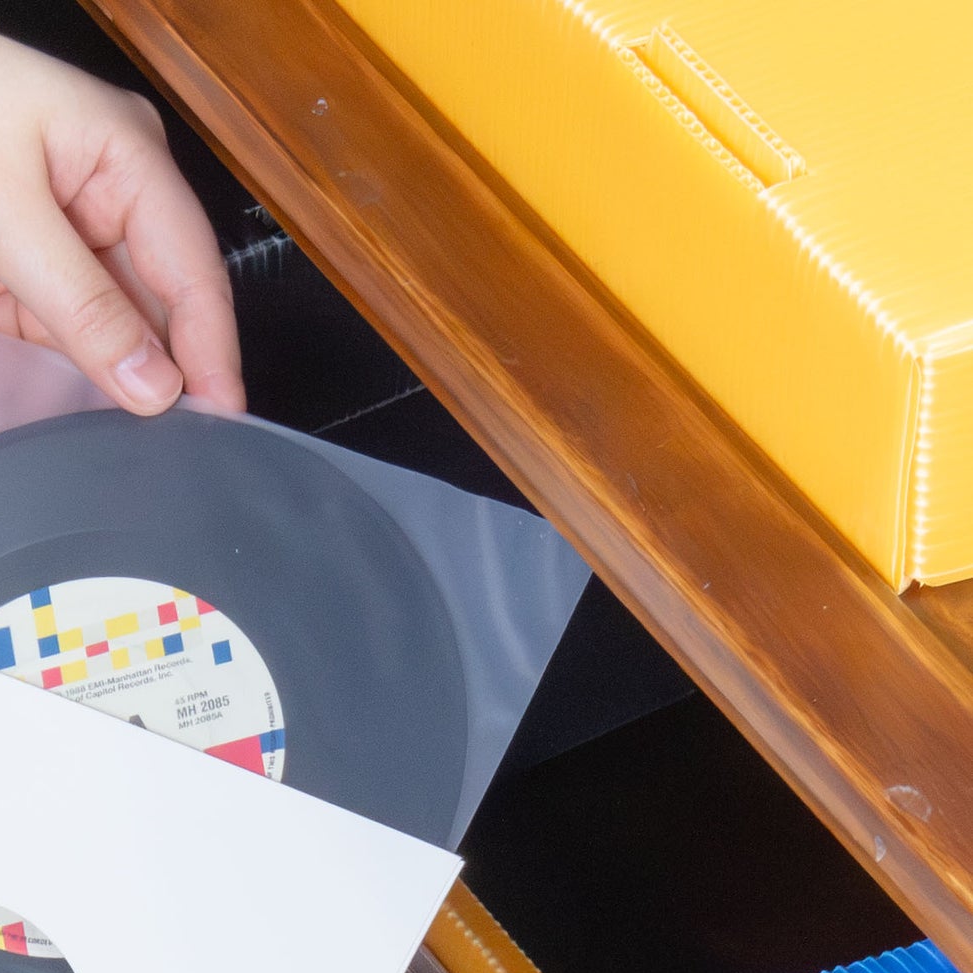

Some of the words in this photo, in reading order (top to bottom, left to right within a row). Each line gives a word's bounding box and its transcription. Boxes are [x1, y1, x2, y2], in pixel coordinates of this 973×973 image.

[85, 687, 116, 700] Capitol
[177, 703, 197, 720] MH
[200, 695, 230, 713] 2085
